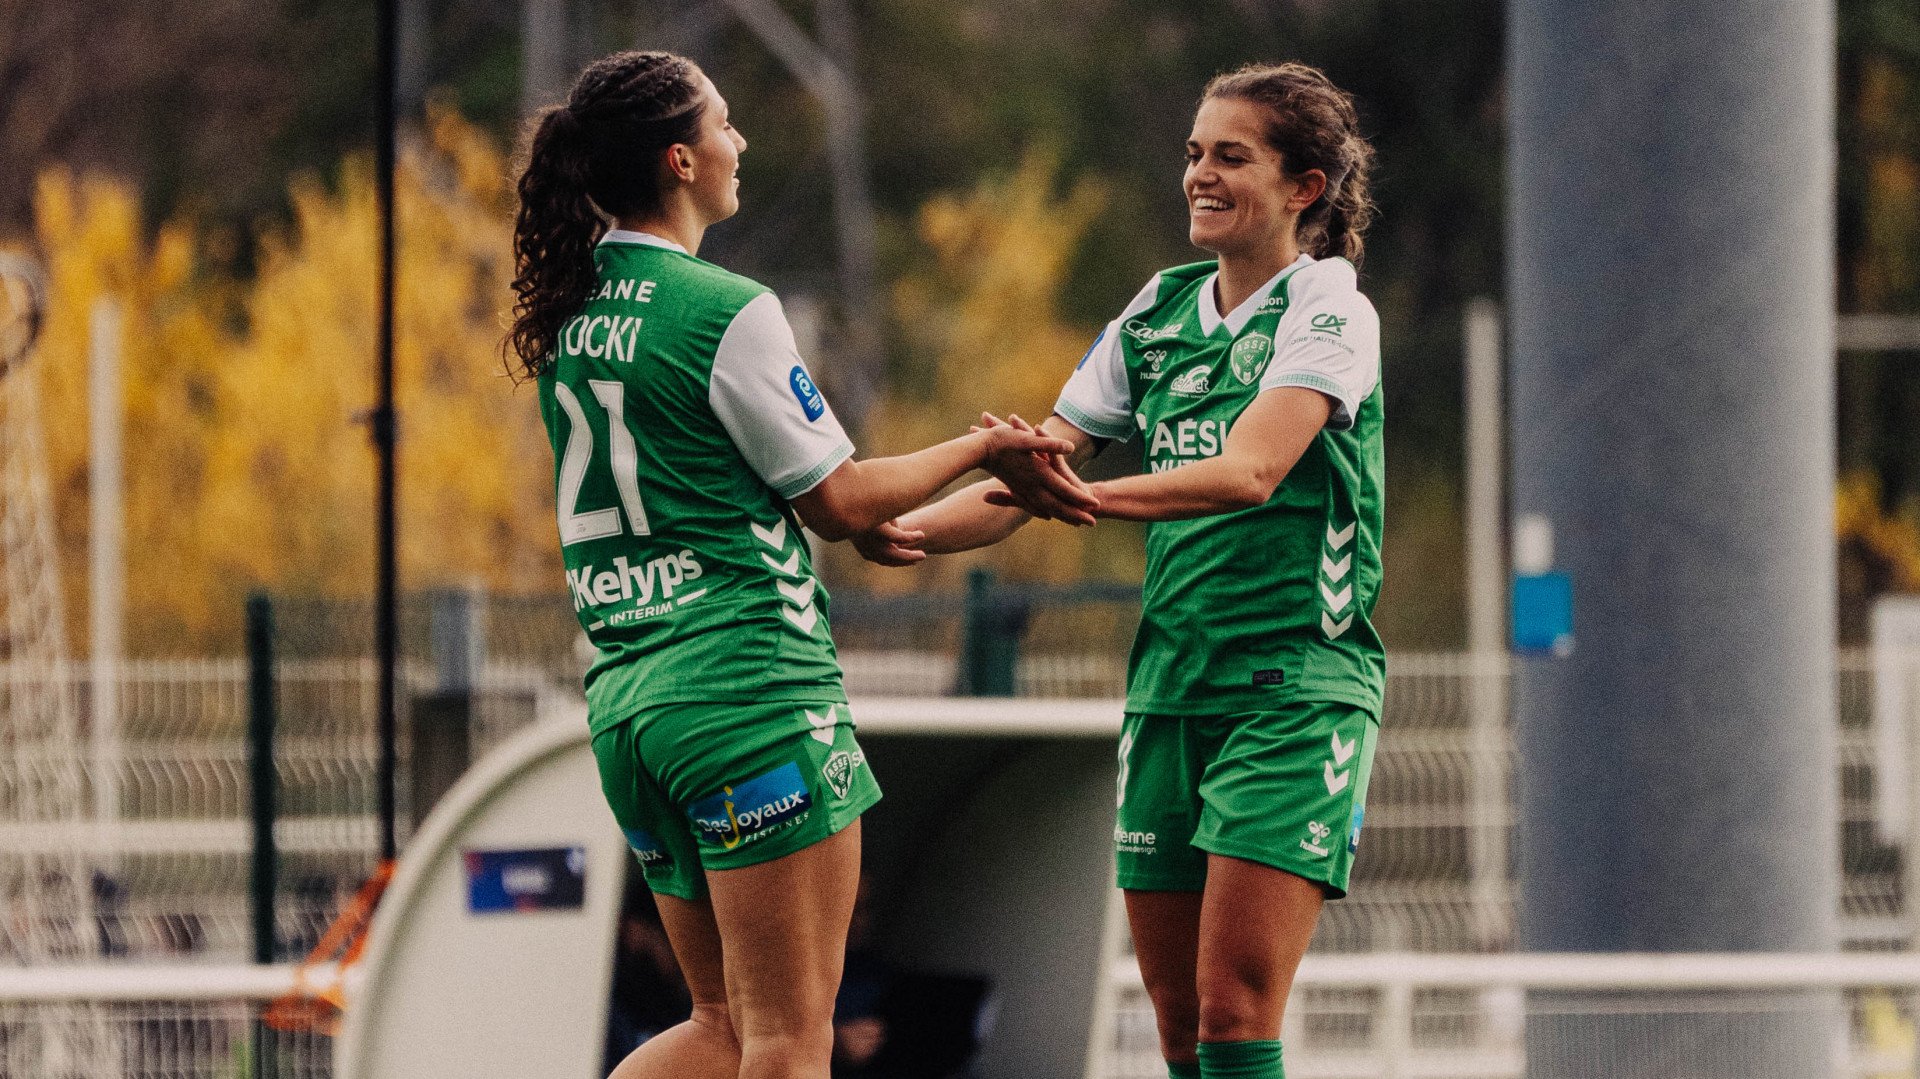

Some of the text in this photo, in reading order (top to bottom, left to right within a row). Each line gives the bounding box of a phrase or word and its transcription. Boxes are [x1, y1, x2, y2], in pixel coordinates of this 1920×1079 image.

[585, 279, 657, 303] ANE
[1236, 339, 1266, 352] ASSE
[1150, 418, 1227, 457] AÉSI
[555, 379, 651, 546] 21
[610, 601, 674, 626] INTERIM
[827, 756, 848, 778] ASSE
